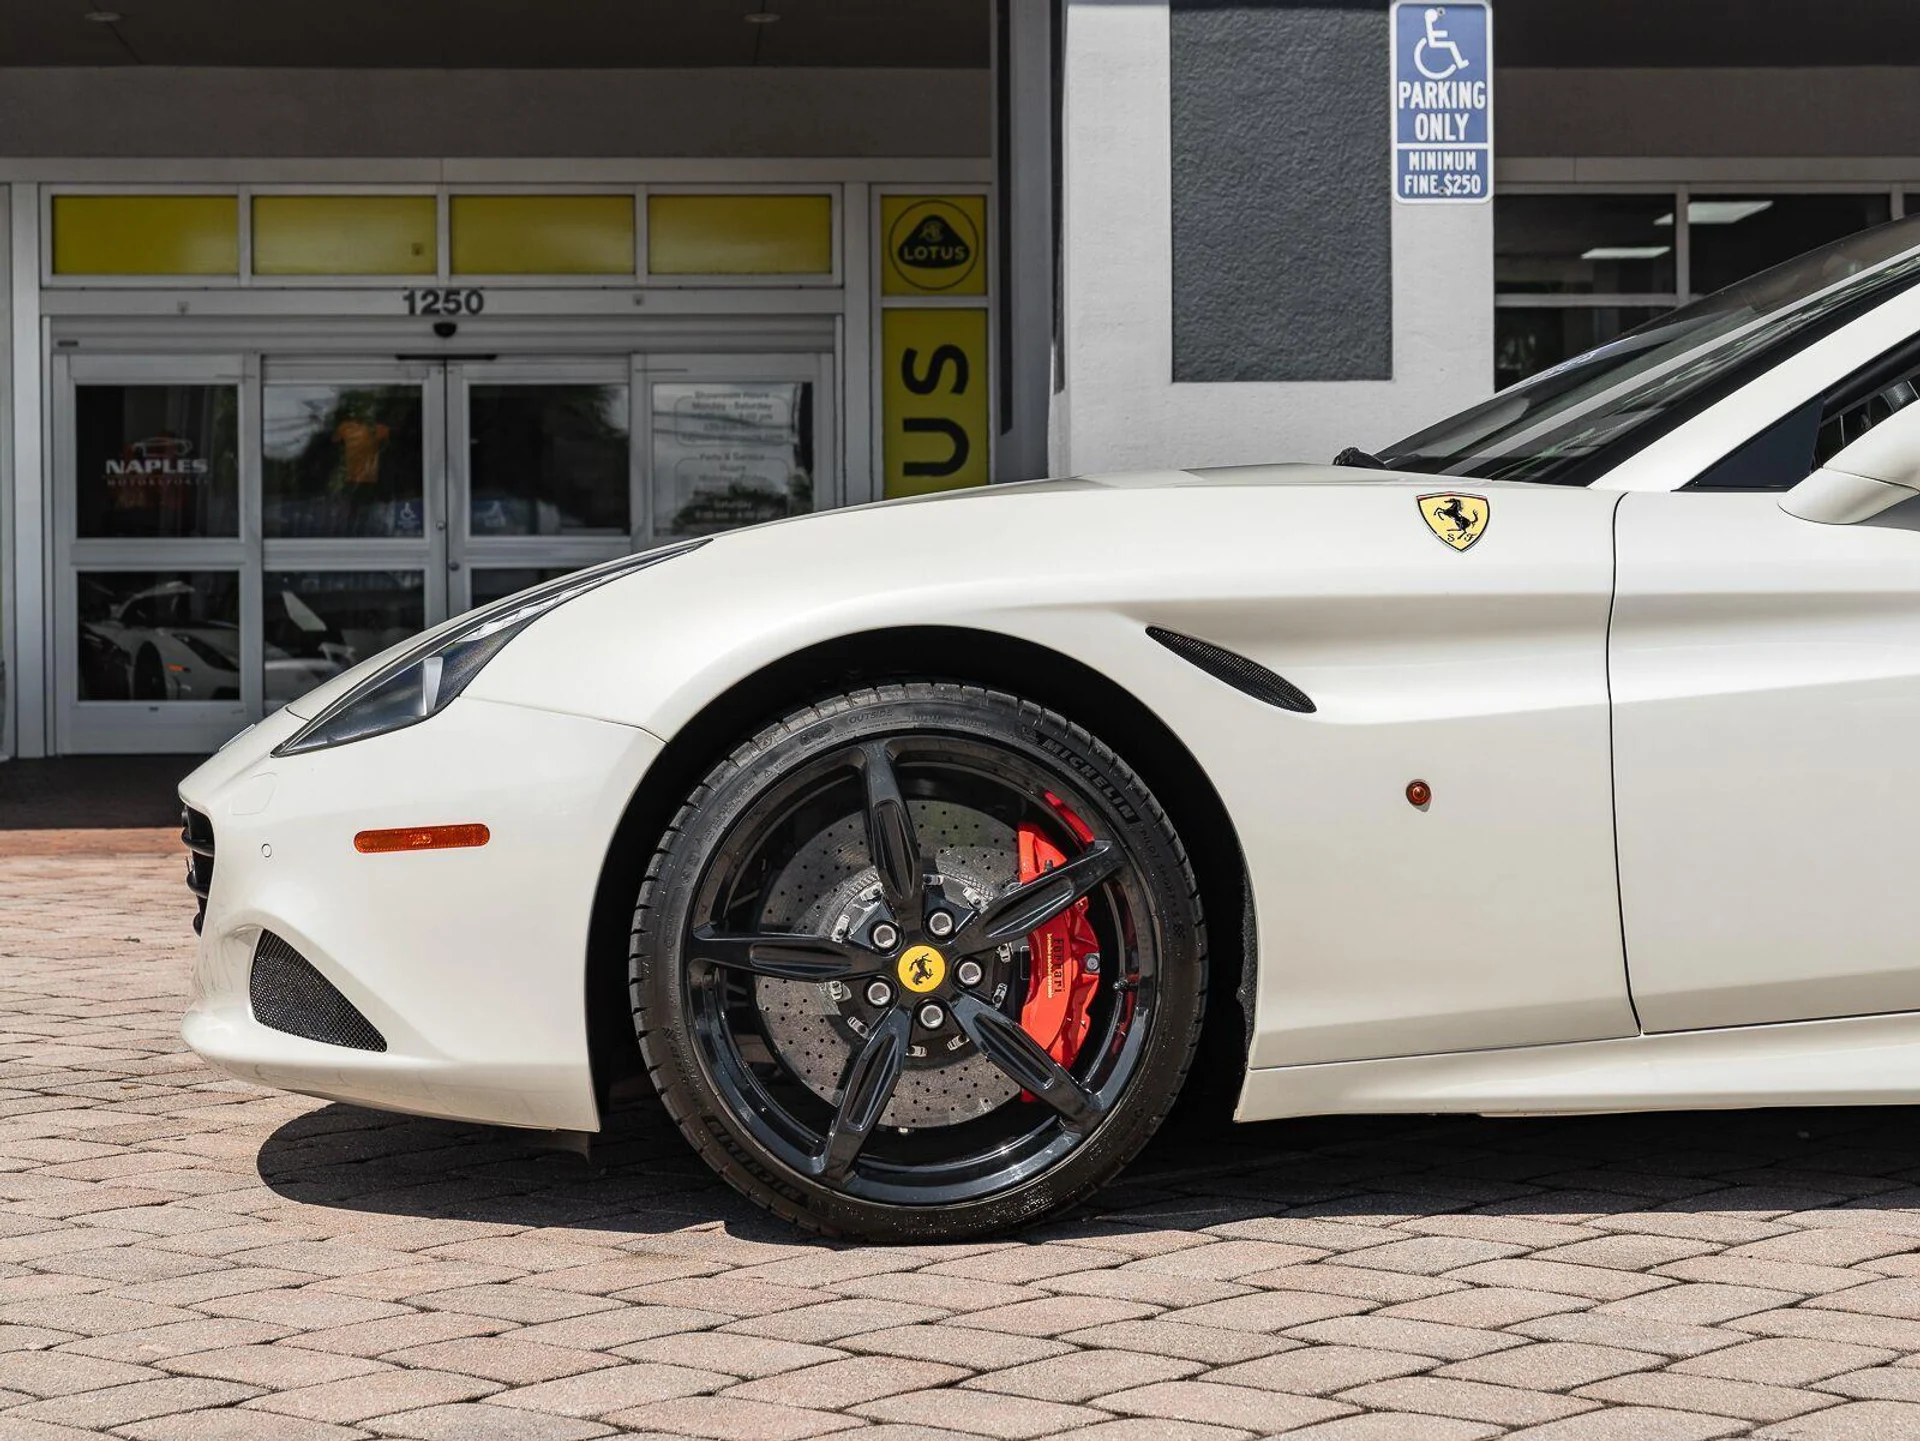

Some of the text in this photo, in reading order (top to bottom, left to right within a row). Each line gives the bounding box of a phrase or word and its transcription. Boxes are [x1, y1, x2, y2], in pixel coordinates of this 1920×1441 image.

[1399, 80, 1486, 110] PARKING
[1415, 113, 1469, 141] ONLY
[1408, 151, 1477, 171] MINIMUM
[1404, 173, 1482, 196] FINE $250
[903, 245, 966, 260] LOTUS
[402, 289, 484, 316] 1250
[105, 459, 209, 474] NAPLES
[849, 711, 893, 724] OUTSIDE
[1040, 737, 1136, 821] MICHELIN
